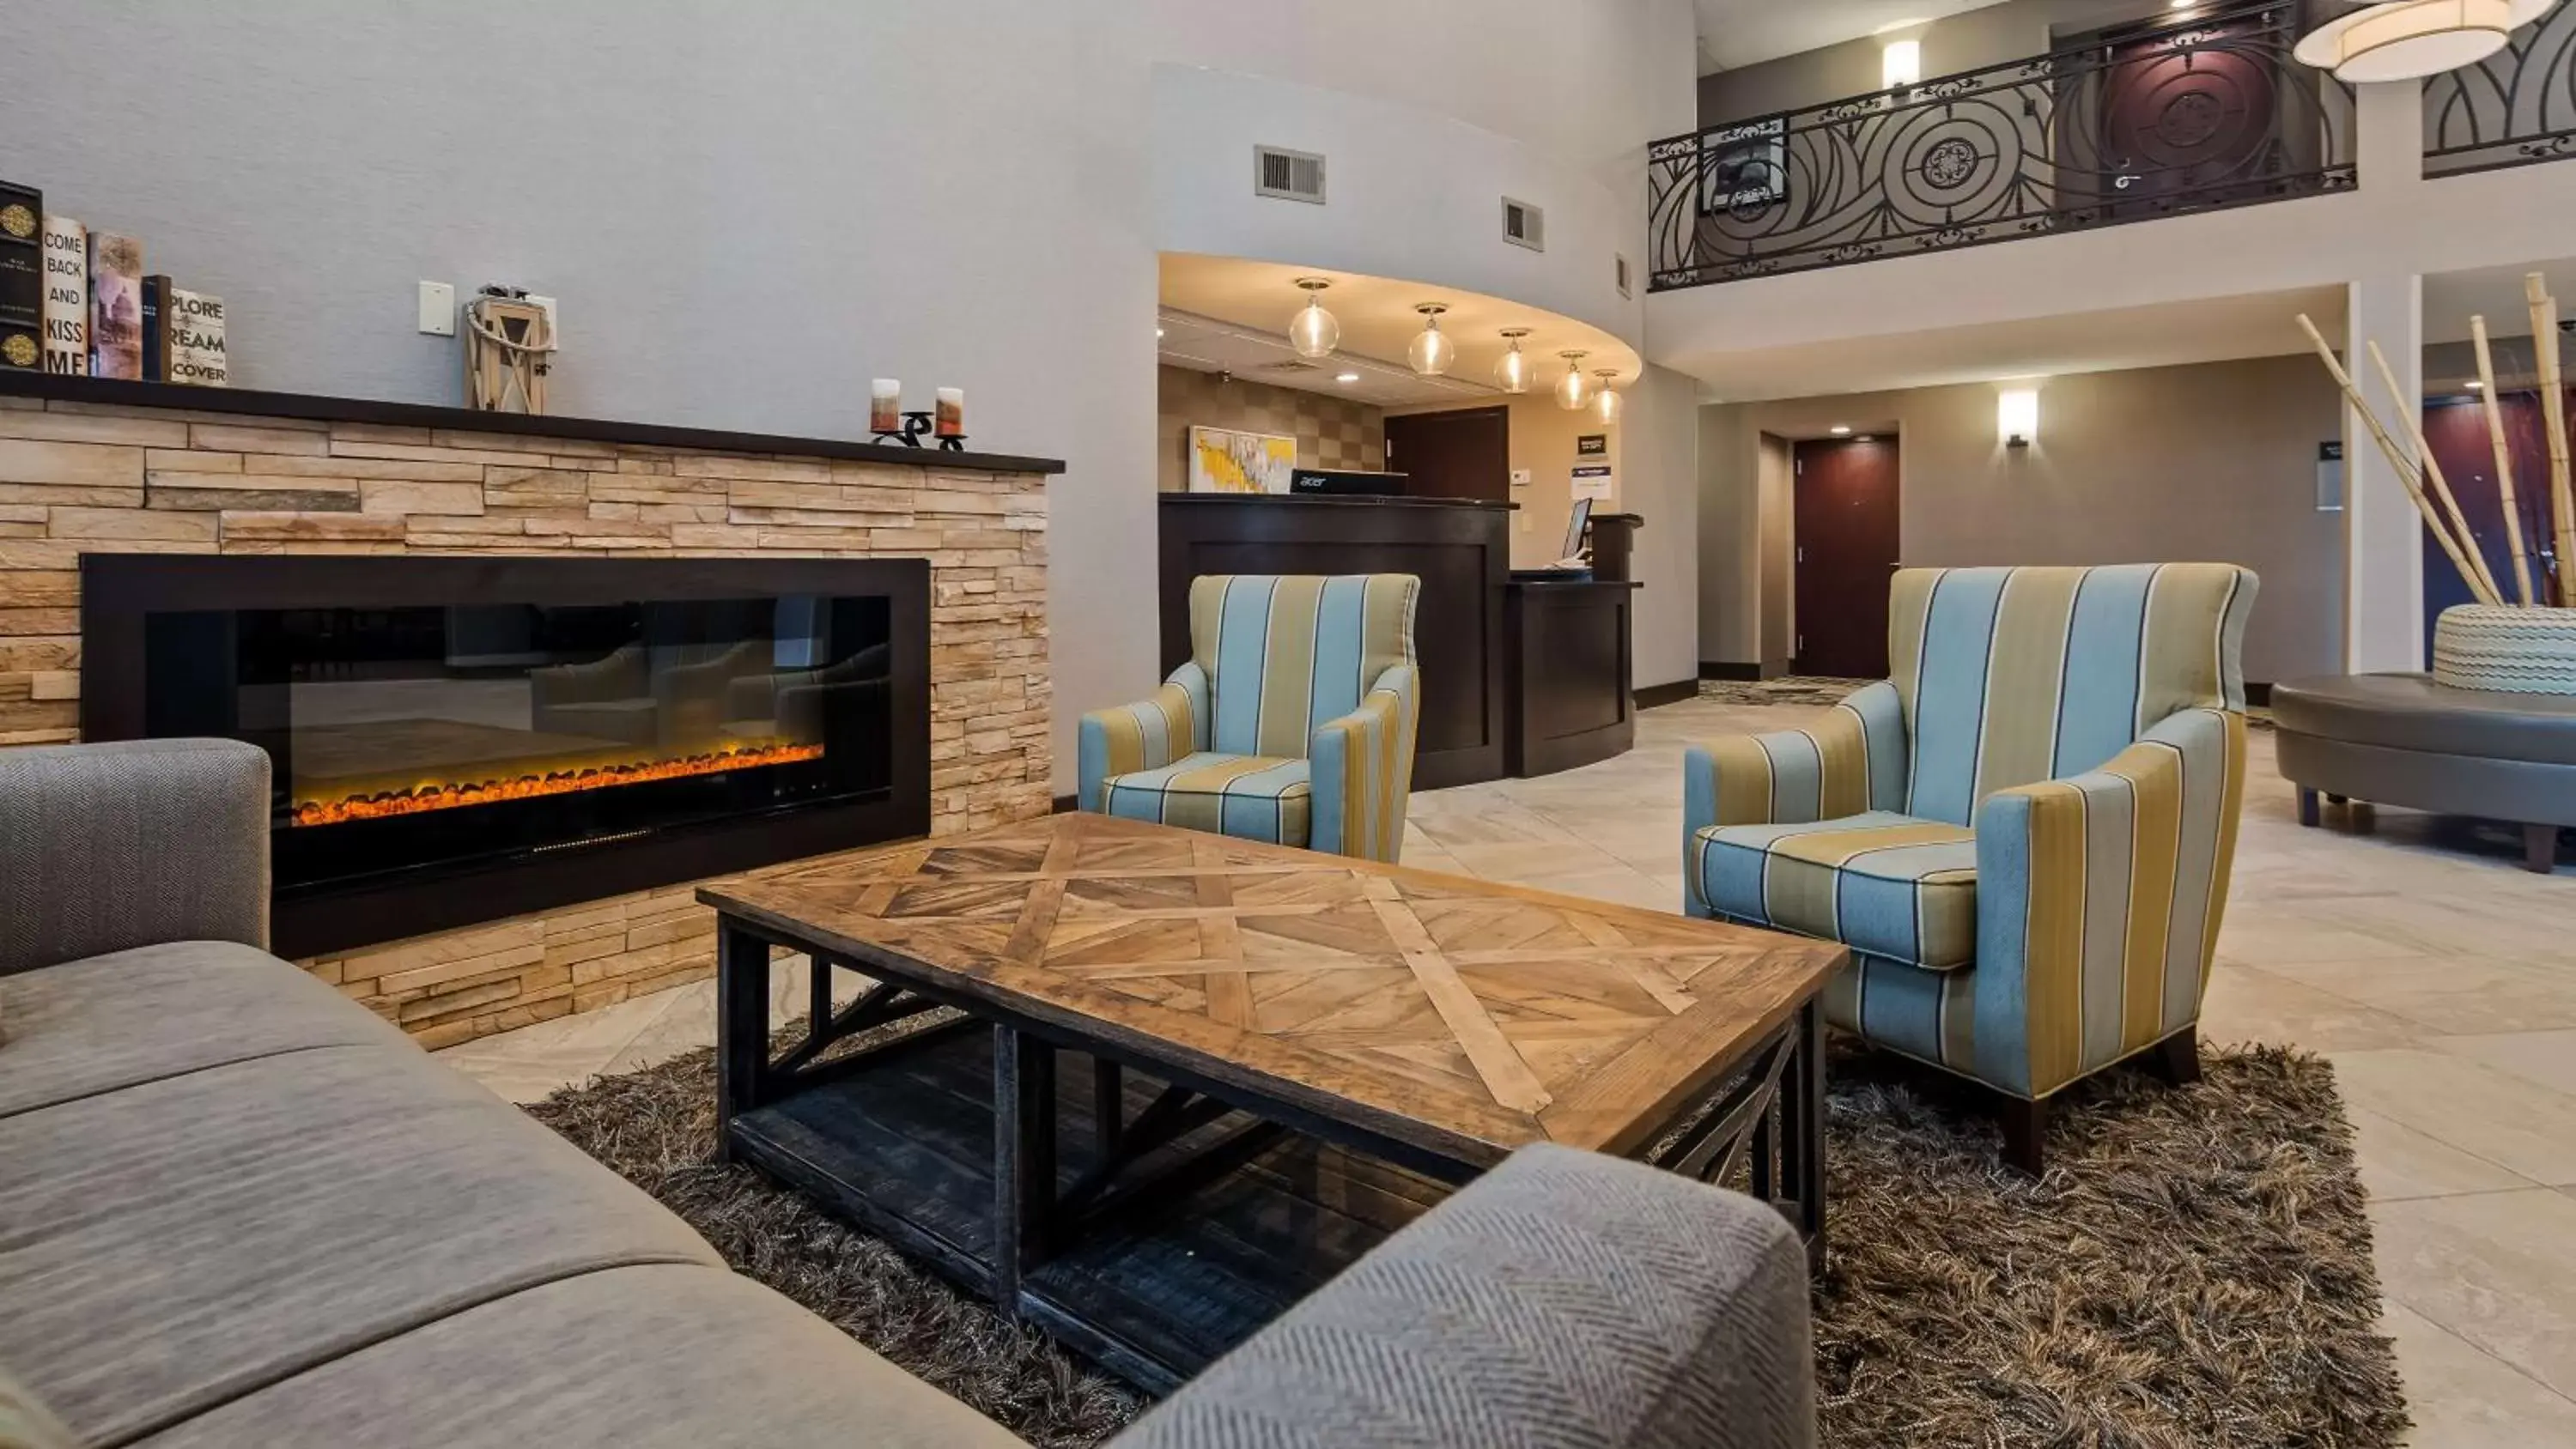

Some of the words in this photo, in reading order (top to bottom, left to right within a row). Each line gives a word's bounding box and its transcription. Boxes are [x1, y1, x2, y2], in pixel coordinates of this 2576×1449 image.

[45, 233, 82, 253] COME
[47, 258, 82, 278] BACK
[49, 287, 80, 305] AND
[46, 318, 83, 343] KISS
[1299, 476, 1327, 487] acer
